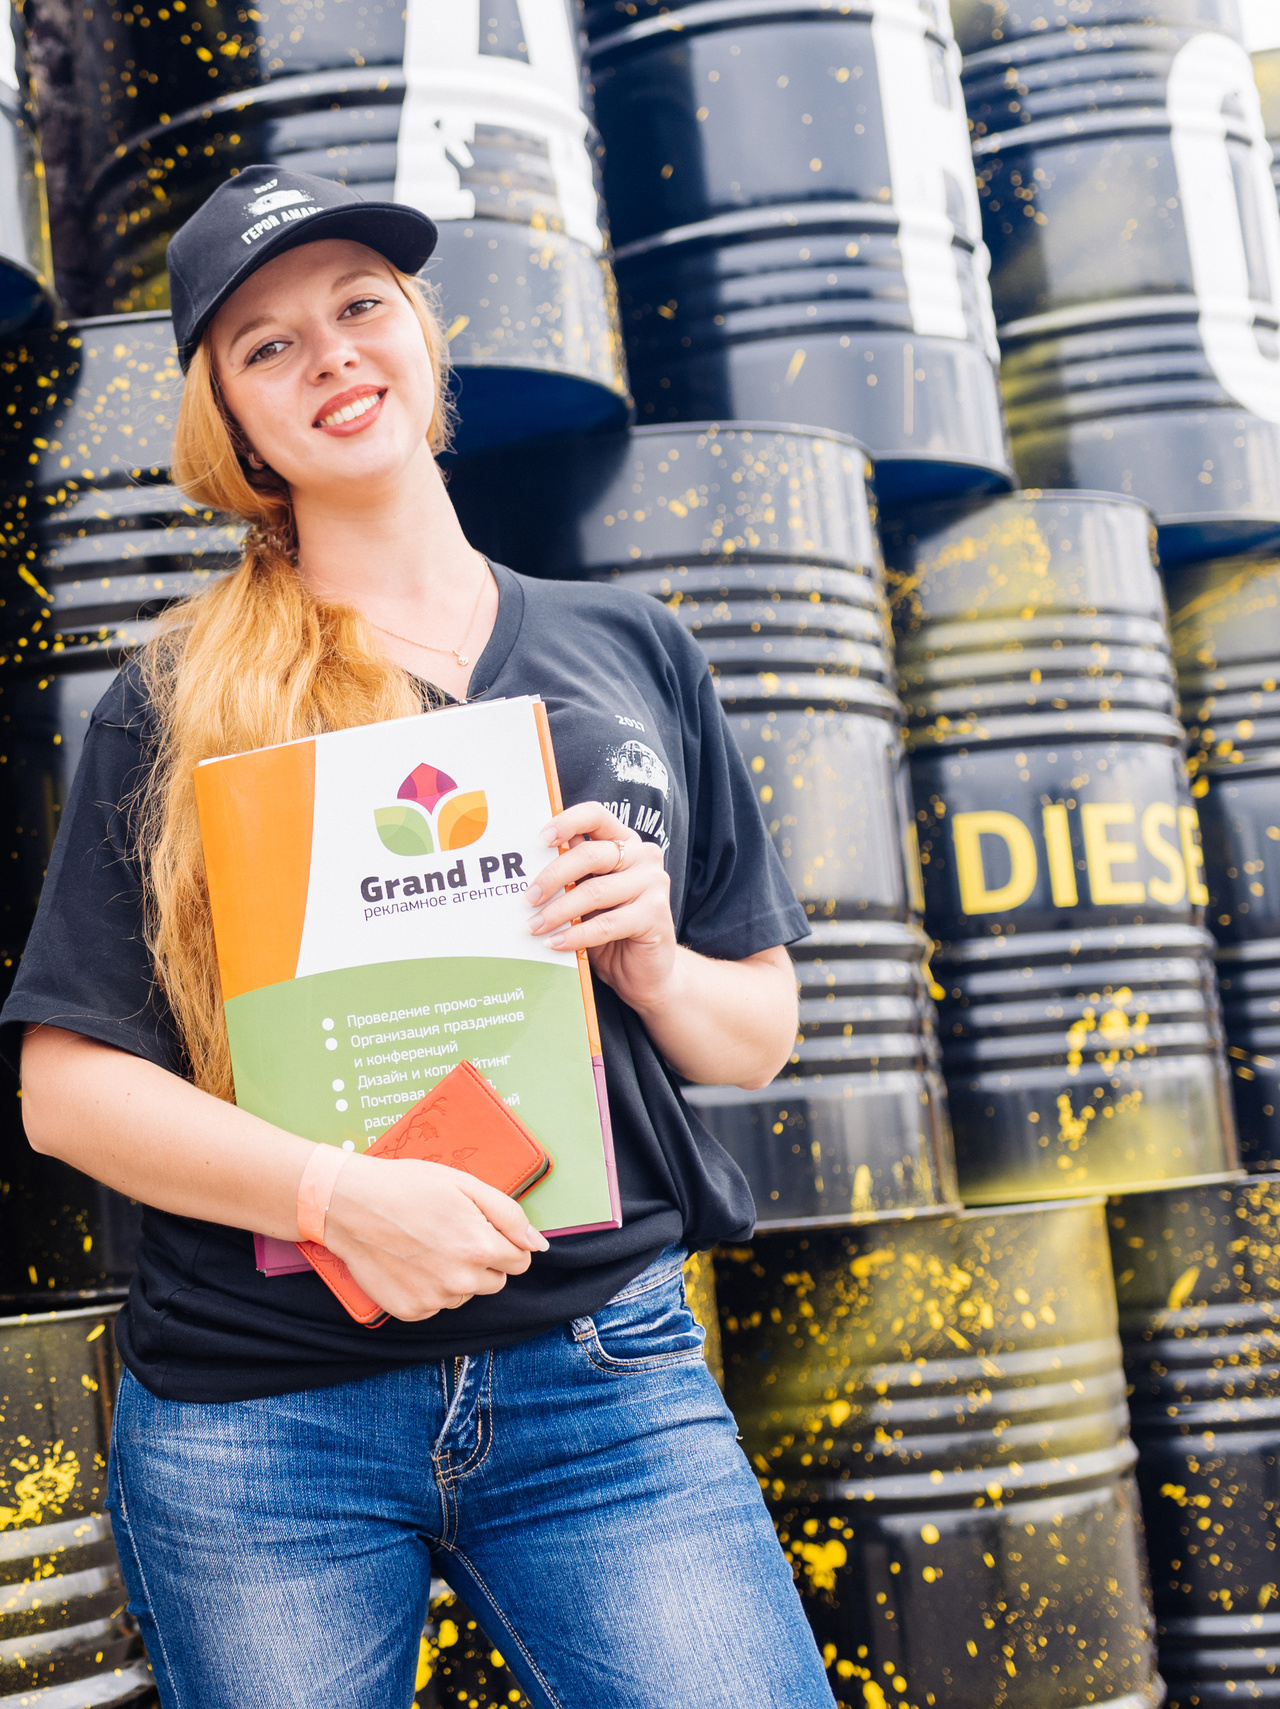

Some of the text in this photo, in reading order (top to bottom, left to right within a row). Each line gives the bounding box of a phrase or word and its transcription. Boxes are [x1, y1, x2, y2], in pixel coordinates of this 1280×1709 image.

[253, 178, 278, 194] 2017
[241, 214, 281, 245] ГЕРОЙ
[614, 714, 646, 732] 2017
[360, 851, 527, 903] Grand PR
[363, 881, 529, 921] рекламное агентство
[346, 987, 525, 1029] Проведение промо-акций
[350, 1010, 525, 1049] Организация праздников
[354, 1040, 458, 1068] и конференций
[357, 1054, 511, 1091] Дизайн и копийтинг
[360, 1088, 426, 1108] Почтовая
